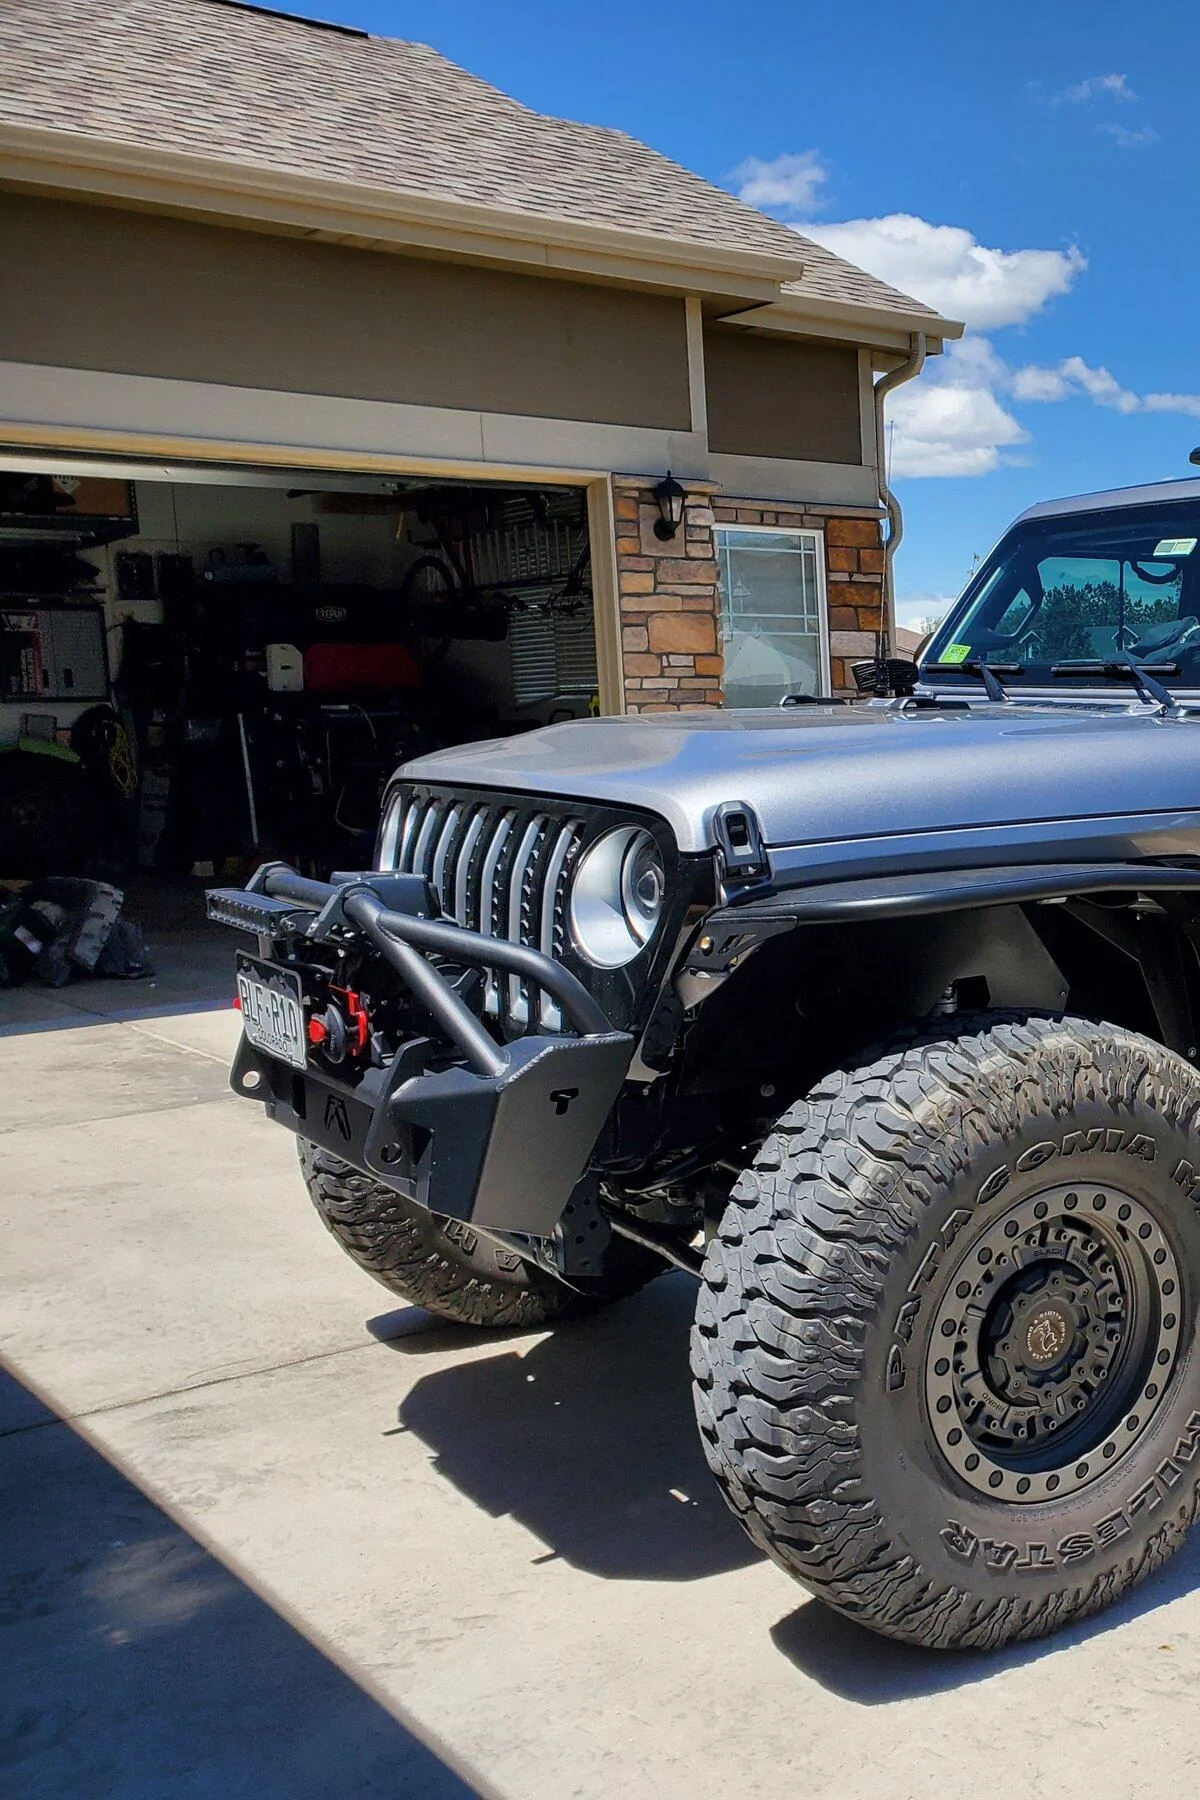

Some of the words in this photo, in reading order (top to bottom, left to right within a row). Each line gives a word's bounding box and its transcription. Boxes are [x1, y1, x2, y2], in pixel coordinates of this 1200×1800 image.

[257, 1028, 288, 1052] COLORADO
[885, 1127, 1159, 1392] PATAGONIA
[1033, 1248, 1063, 1257] BLACK
[982, 1392, 1006, 1412] RHINO
